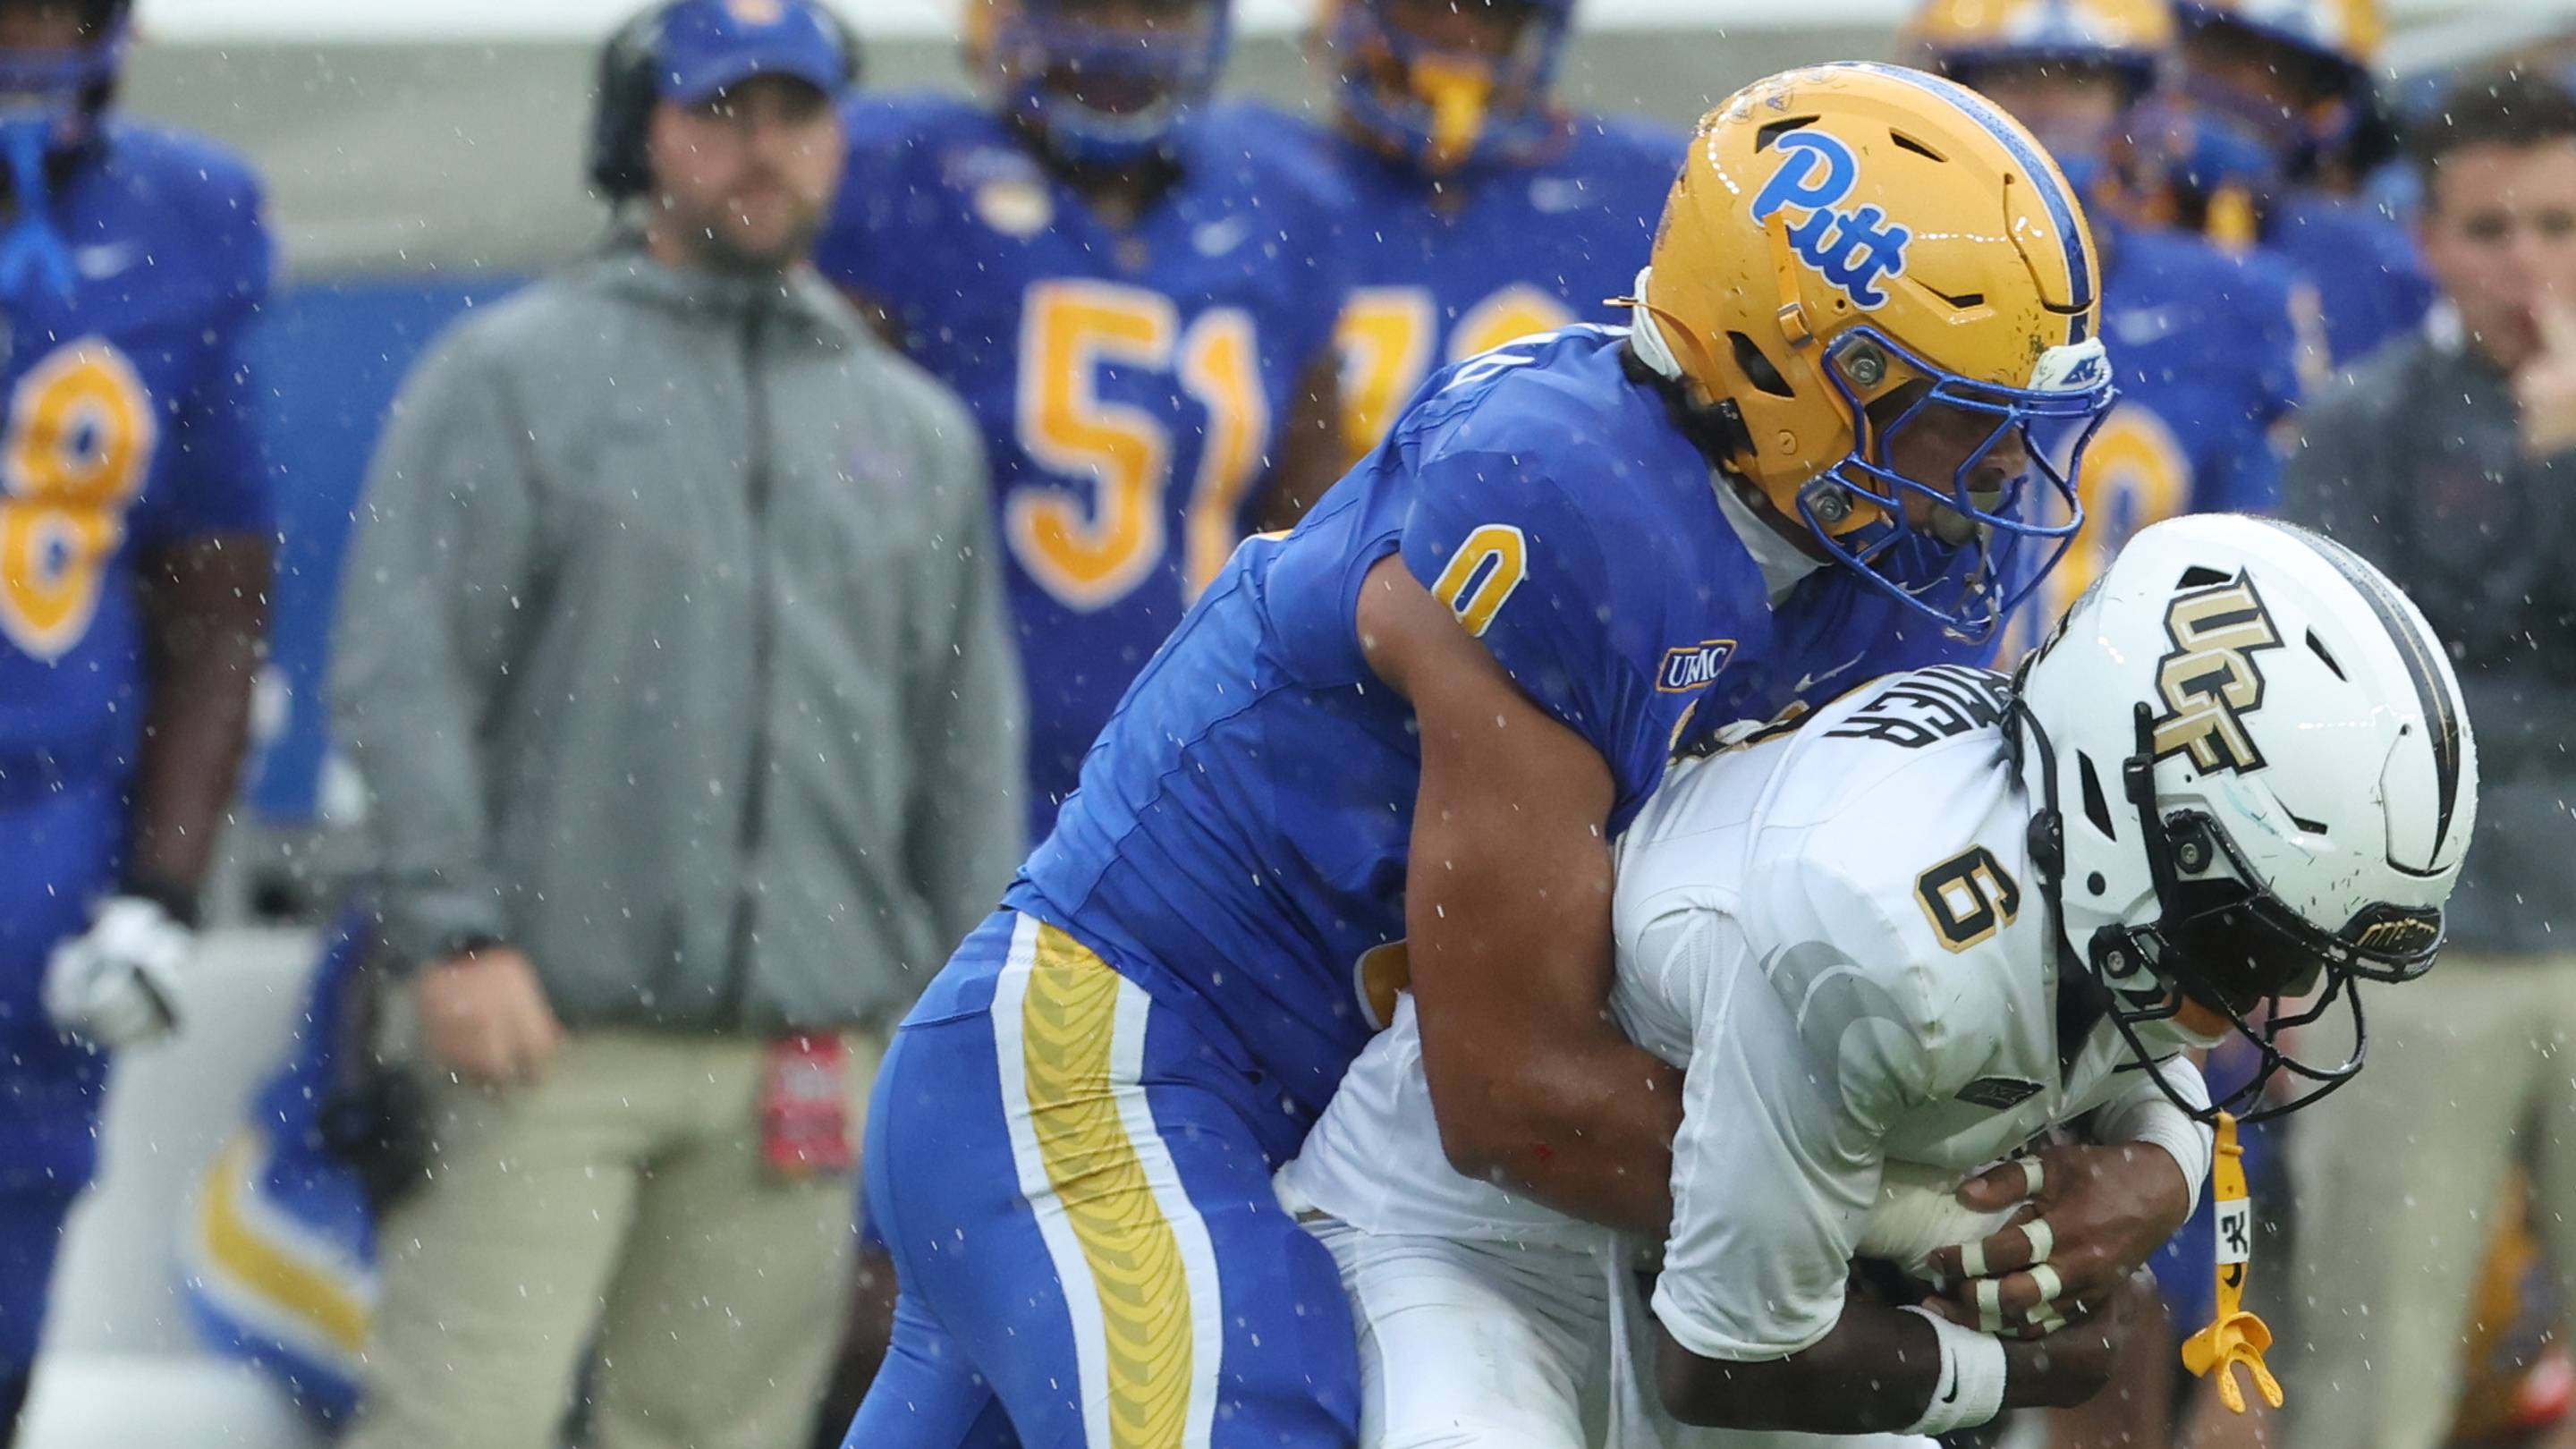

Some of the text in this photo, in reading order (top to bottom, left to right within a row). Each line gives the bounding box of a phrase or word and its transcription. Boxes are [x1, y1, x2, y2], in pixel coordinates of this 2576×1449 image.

[1750, 129, 1912, 310] Pitt
[1005, 279, 1270, 615] 51
[1431, 524, 1527, 638] 0
[2155, 565, 2285, 776] UCF
[1913, 843, 2020, 954] 6
